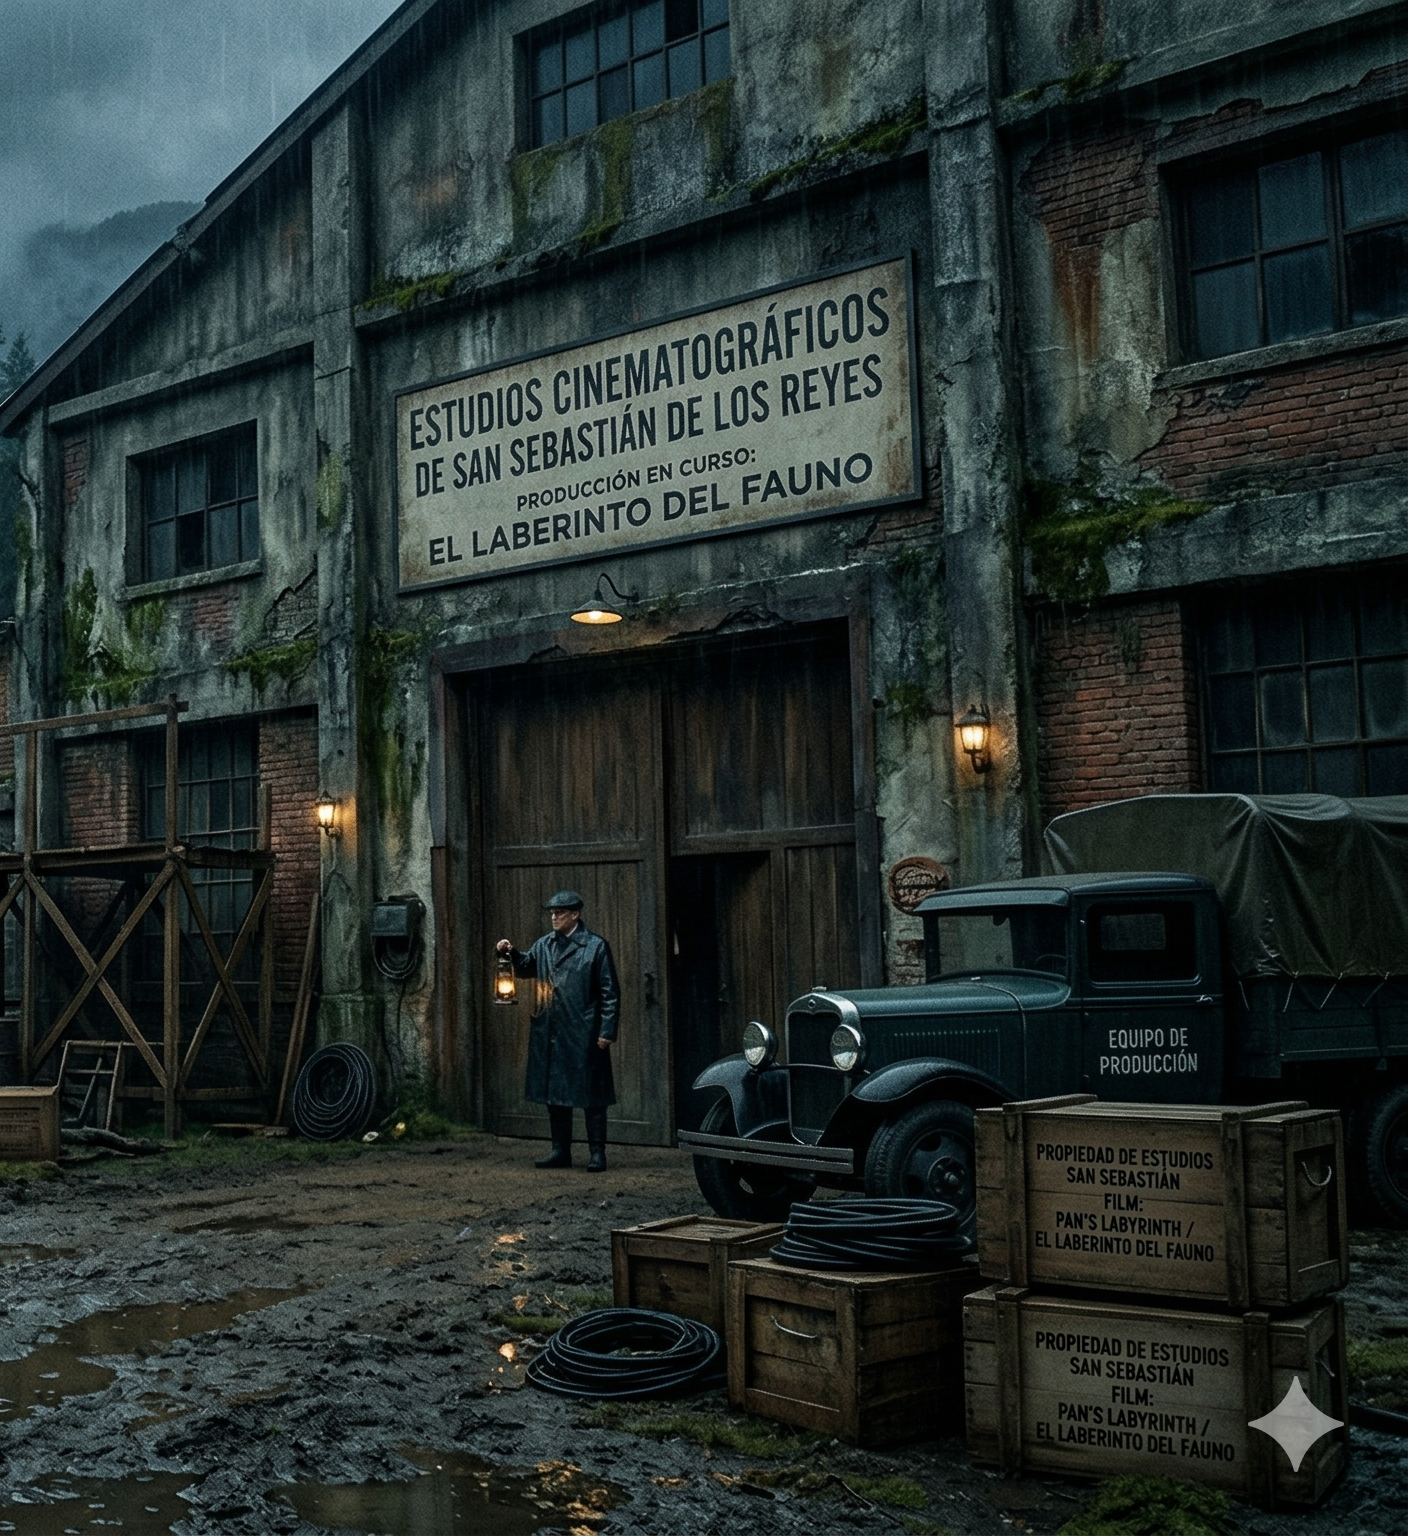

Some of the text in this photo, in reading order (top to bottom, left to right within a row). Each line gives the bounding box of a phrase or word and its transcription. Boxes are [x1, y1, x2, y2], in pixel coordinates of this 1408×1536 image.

[410, 287, 890, 451] ESTUDIOS CINEMATOGRÁFICOS
[416, 353, 883, 498] DE SAN SEBASTIÁN DE LOS REYES
[517, 447, 756, 511] PRODUCCIÓN EN CURSO:
[429, 452, 873, 566] EL LABERINTO DEL FAUNO
[1108, 1027, 1189, 1049] EQUIPO DE
[1099, 1048, 1198, 1075] PRODUCCIÓN
[1036, 1143, 1214, 1170] PROPIEDAD DE ESTUDIOS
[1066, 1166, 1180, 1190] SAN SEBASTIÁN
[1104, 1193, 1144, 1212] FILM:
[1056, 1211, 1195, 1238] PAN'S LABYRINTH /
[1035, 1230, 1214, 1263] EL LABERINTO DEL FAUNO
[1035, 1331, 1229, 1367] PROPIEDAD DE ESTUDIOS
[1070, 1356, 1194, 1387] SAN SEBASTIÁN
[1111, 1385, 1154, 1406] FILM:
[1058, 1402, 1210, 1437] PAN'S LABYRINTH /
[1036, 1421, 1235, 1462] EL LABERINTO DEL FAUNO
